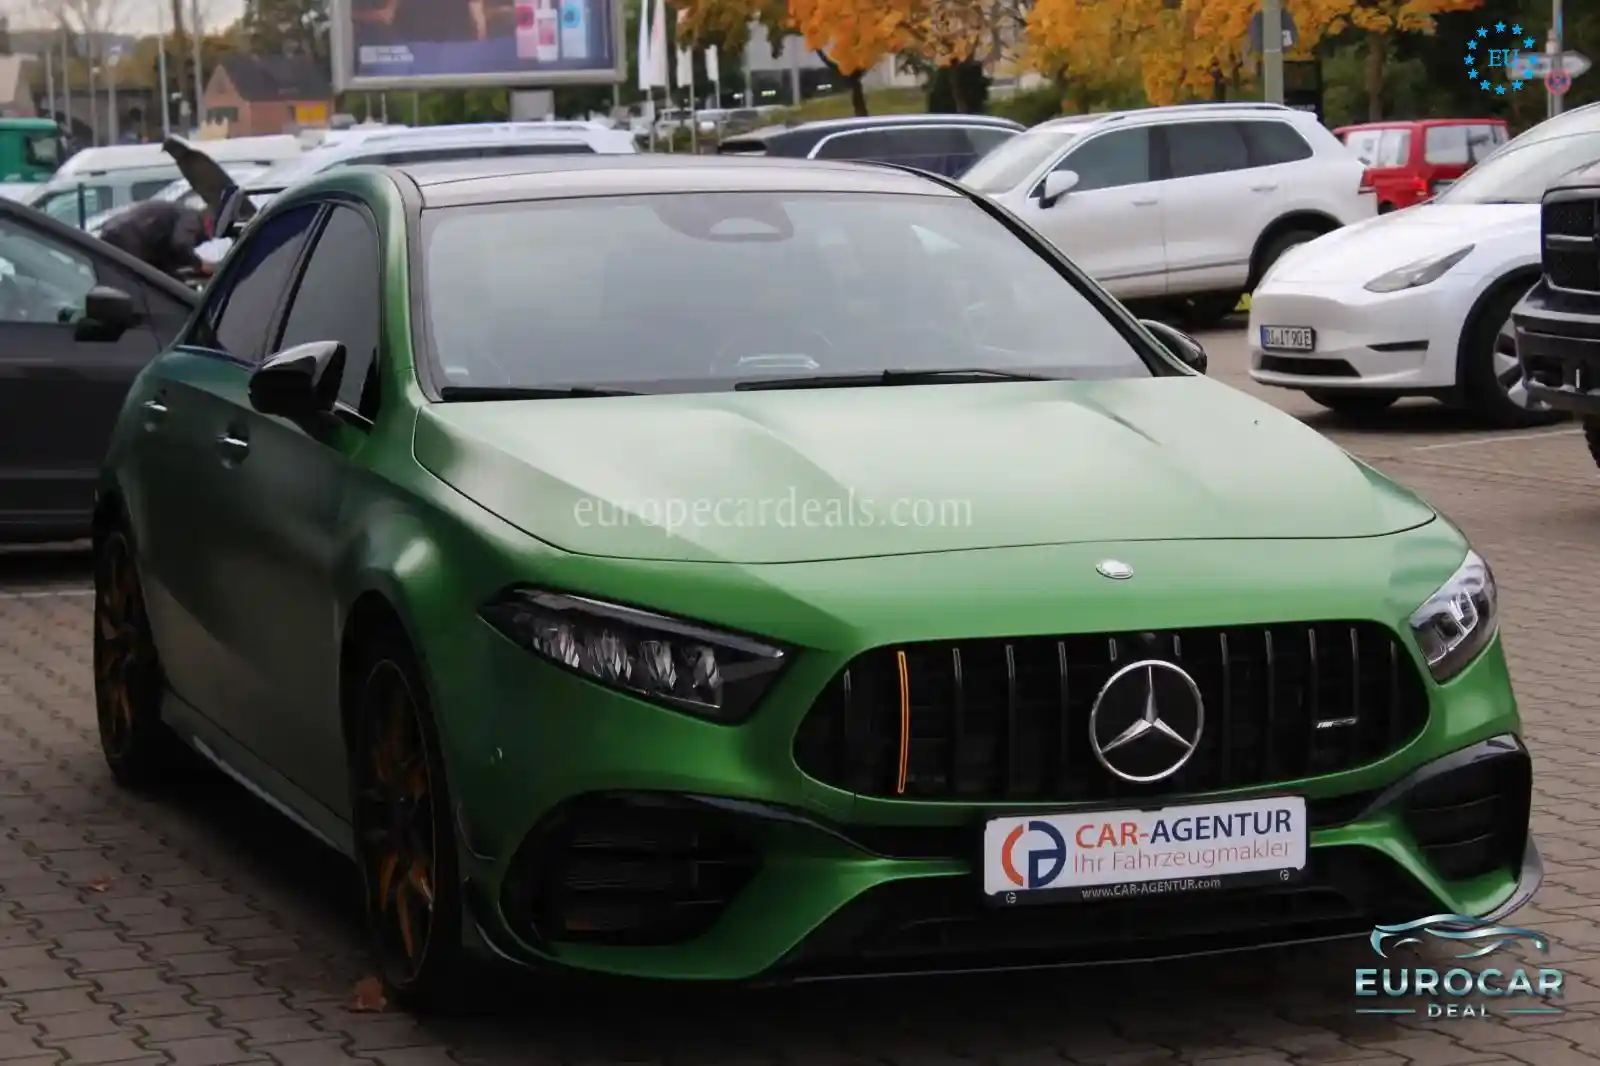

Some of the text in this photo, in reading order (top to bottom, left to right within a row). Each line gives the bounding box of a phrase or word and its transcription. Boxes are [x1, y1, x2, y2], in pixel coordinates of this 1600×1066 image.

[1074, 808, 1292, 850] CAR-AGENTUR
[1073, 838, 1291, 874] Ihr Fahrzeugmakler
[1081, 877, 1221, 899] www.CAR-AGENTUR.com
